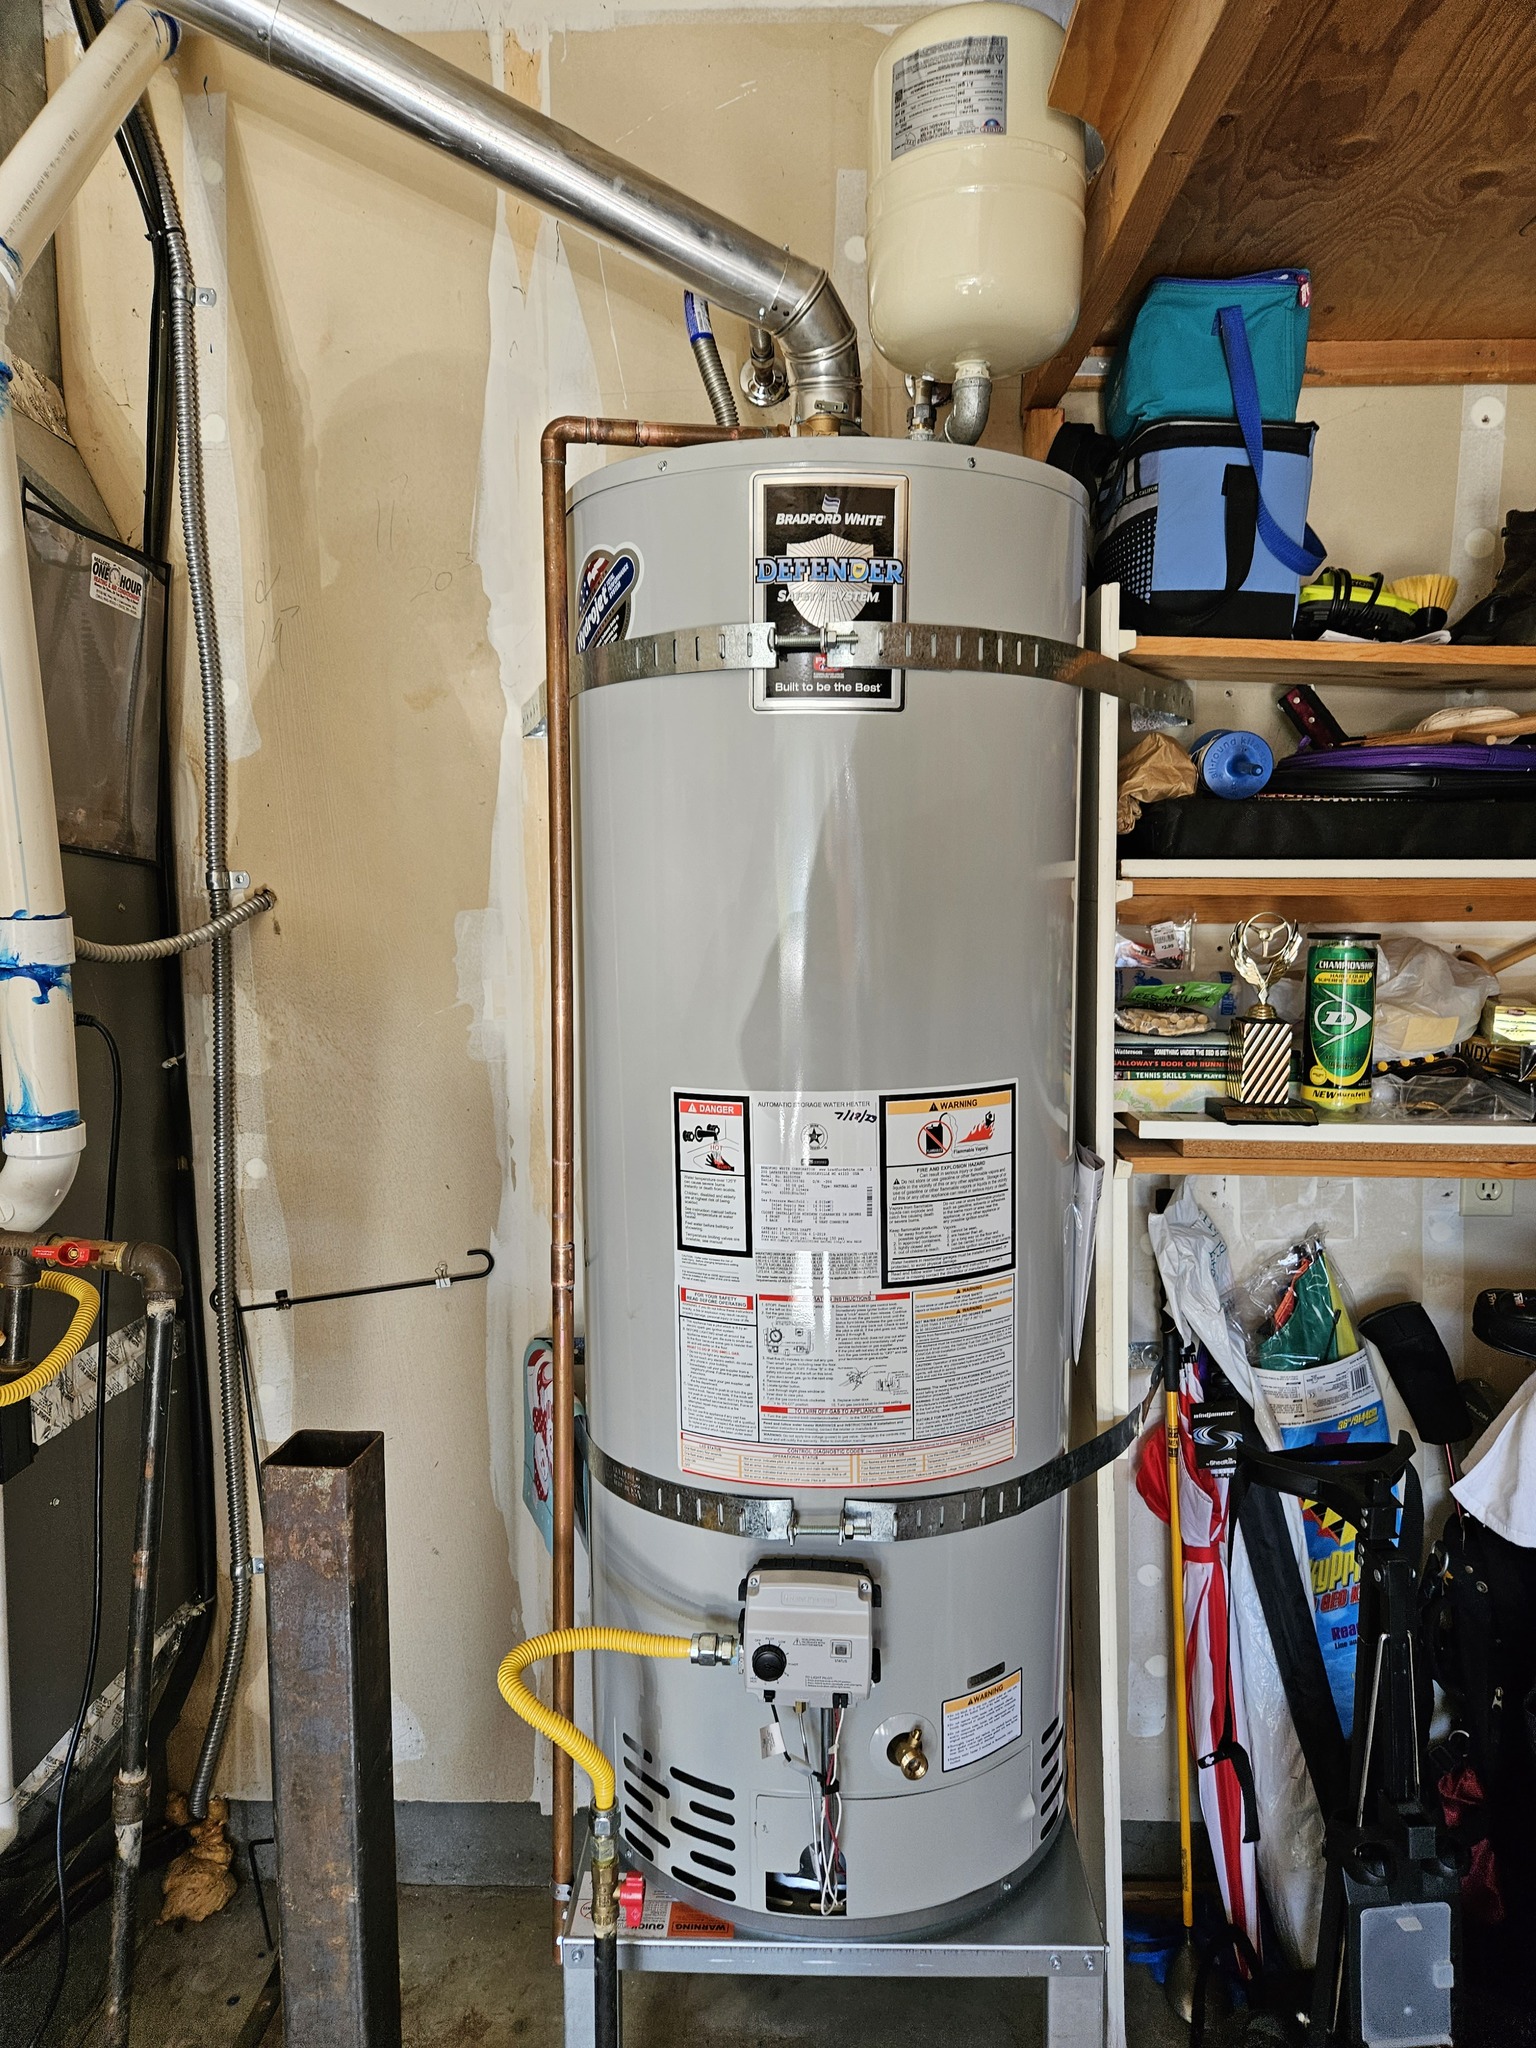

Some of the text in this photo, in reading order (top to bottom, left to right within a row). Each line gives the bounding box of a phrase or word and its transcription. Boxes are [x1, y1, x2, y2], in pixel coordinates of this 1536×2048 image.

[776, 513, 883, 526] BRADFORD WHITE
[75, 574, 127, 583] DEFENDER
[93, 562, 110, 580] ONE
[120, 575, 142, 596] HOUR
[775, 683, 881, 692] Built to be the Best
[1313, 1090, 1336, 1098] NEW
[700, 1104, 734, 1114] DANGER
[940, 1099, 977, 1109] WARNING
[1194, 1411, 1234, 1419] windjammer
[973, 1684, 1003, 1703] WARNING
